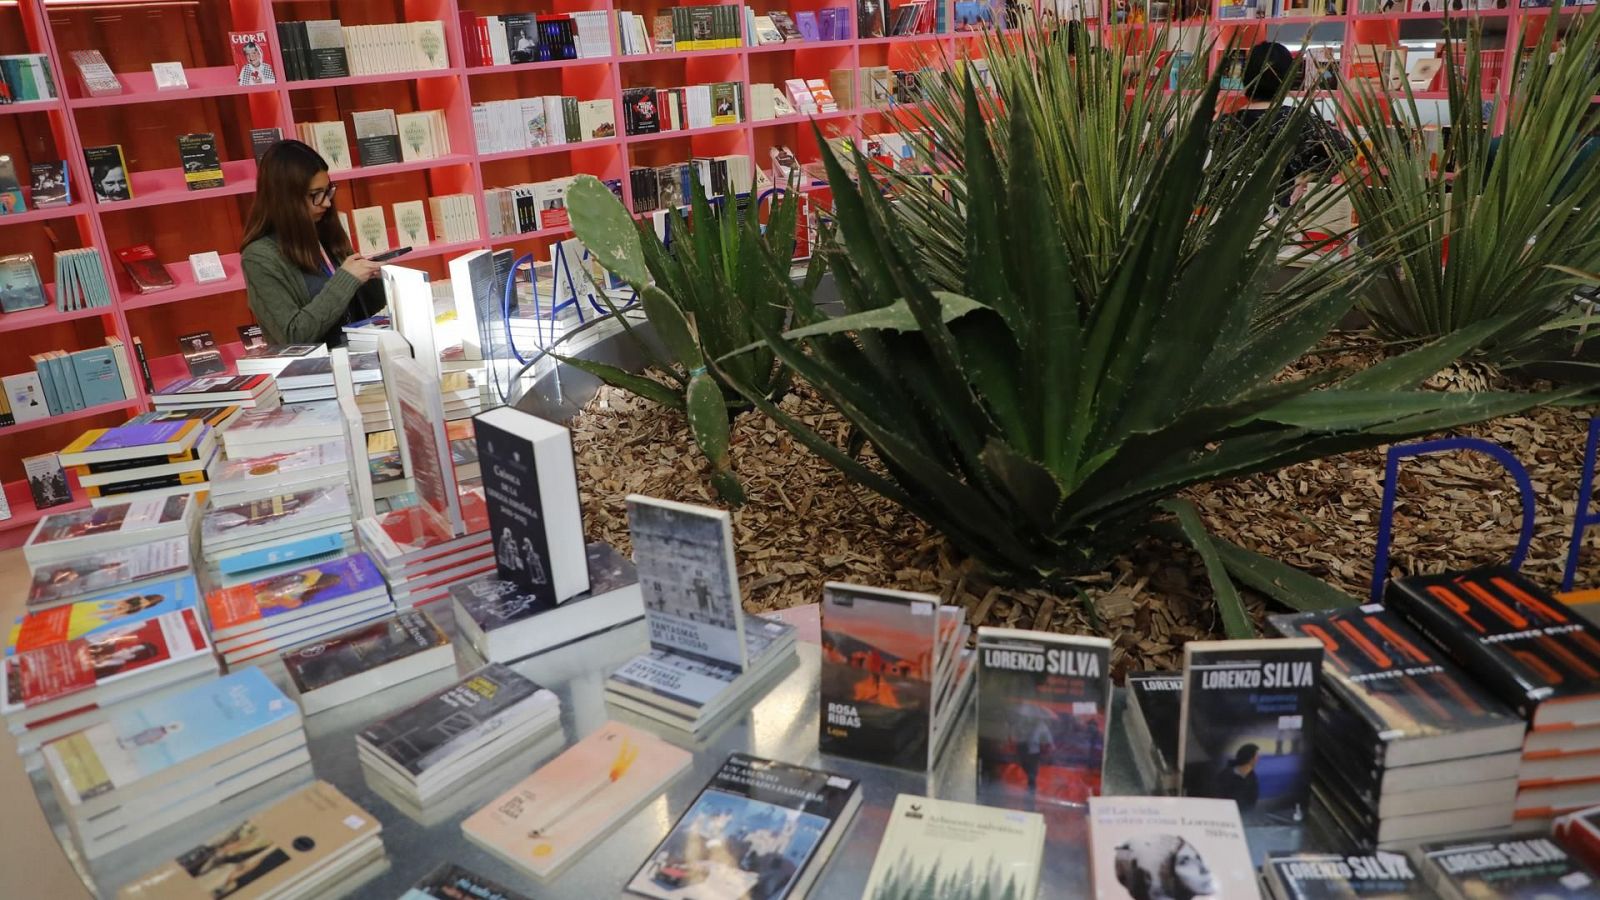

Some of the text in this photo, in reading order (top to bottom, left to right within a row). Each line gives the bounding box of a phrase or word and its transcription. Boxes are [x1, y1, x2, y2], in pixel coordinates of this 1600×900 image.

[650, 620, 700, 641] FANTASMAS
[1480, 624, 1584, 645] LORENZO SILVA
[652, 630, 709, 652] DE LA CIUDAD
[631, 662, 681, 682] FANTASMAS
[984, 648, 1101, 678] LORENZO SILVA
[1405, 664, 1445, 676] SILVA
[1142, 679, 1185, 692] LORENZ
[1202, 661, 1314, 690] LORENZO SILVA
[828, 702, 859, 717] ROSA
[828, 712, 862, 729] RIBAS
[1437, 850, 1511, 874] LORENZO
[1498, 838, 1569, 866] SILVA
[1280, 861, 1354, 881] LORENZO
